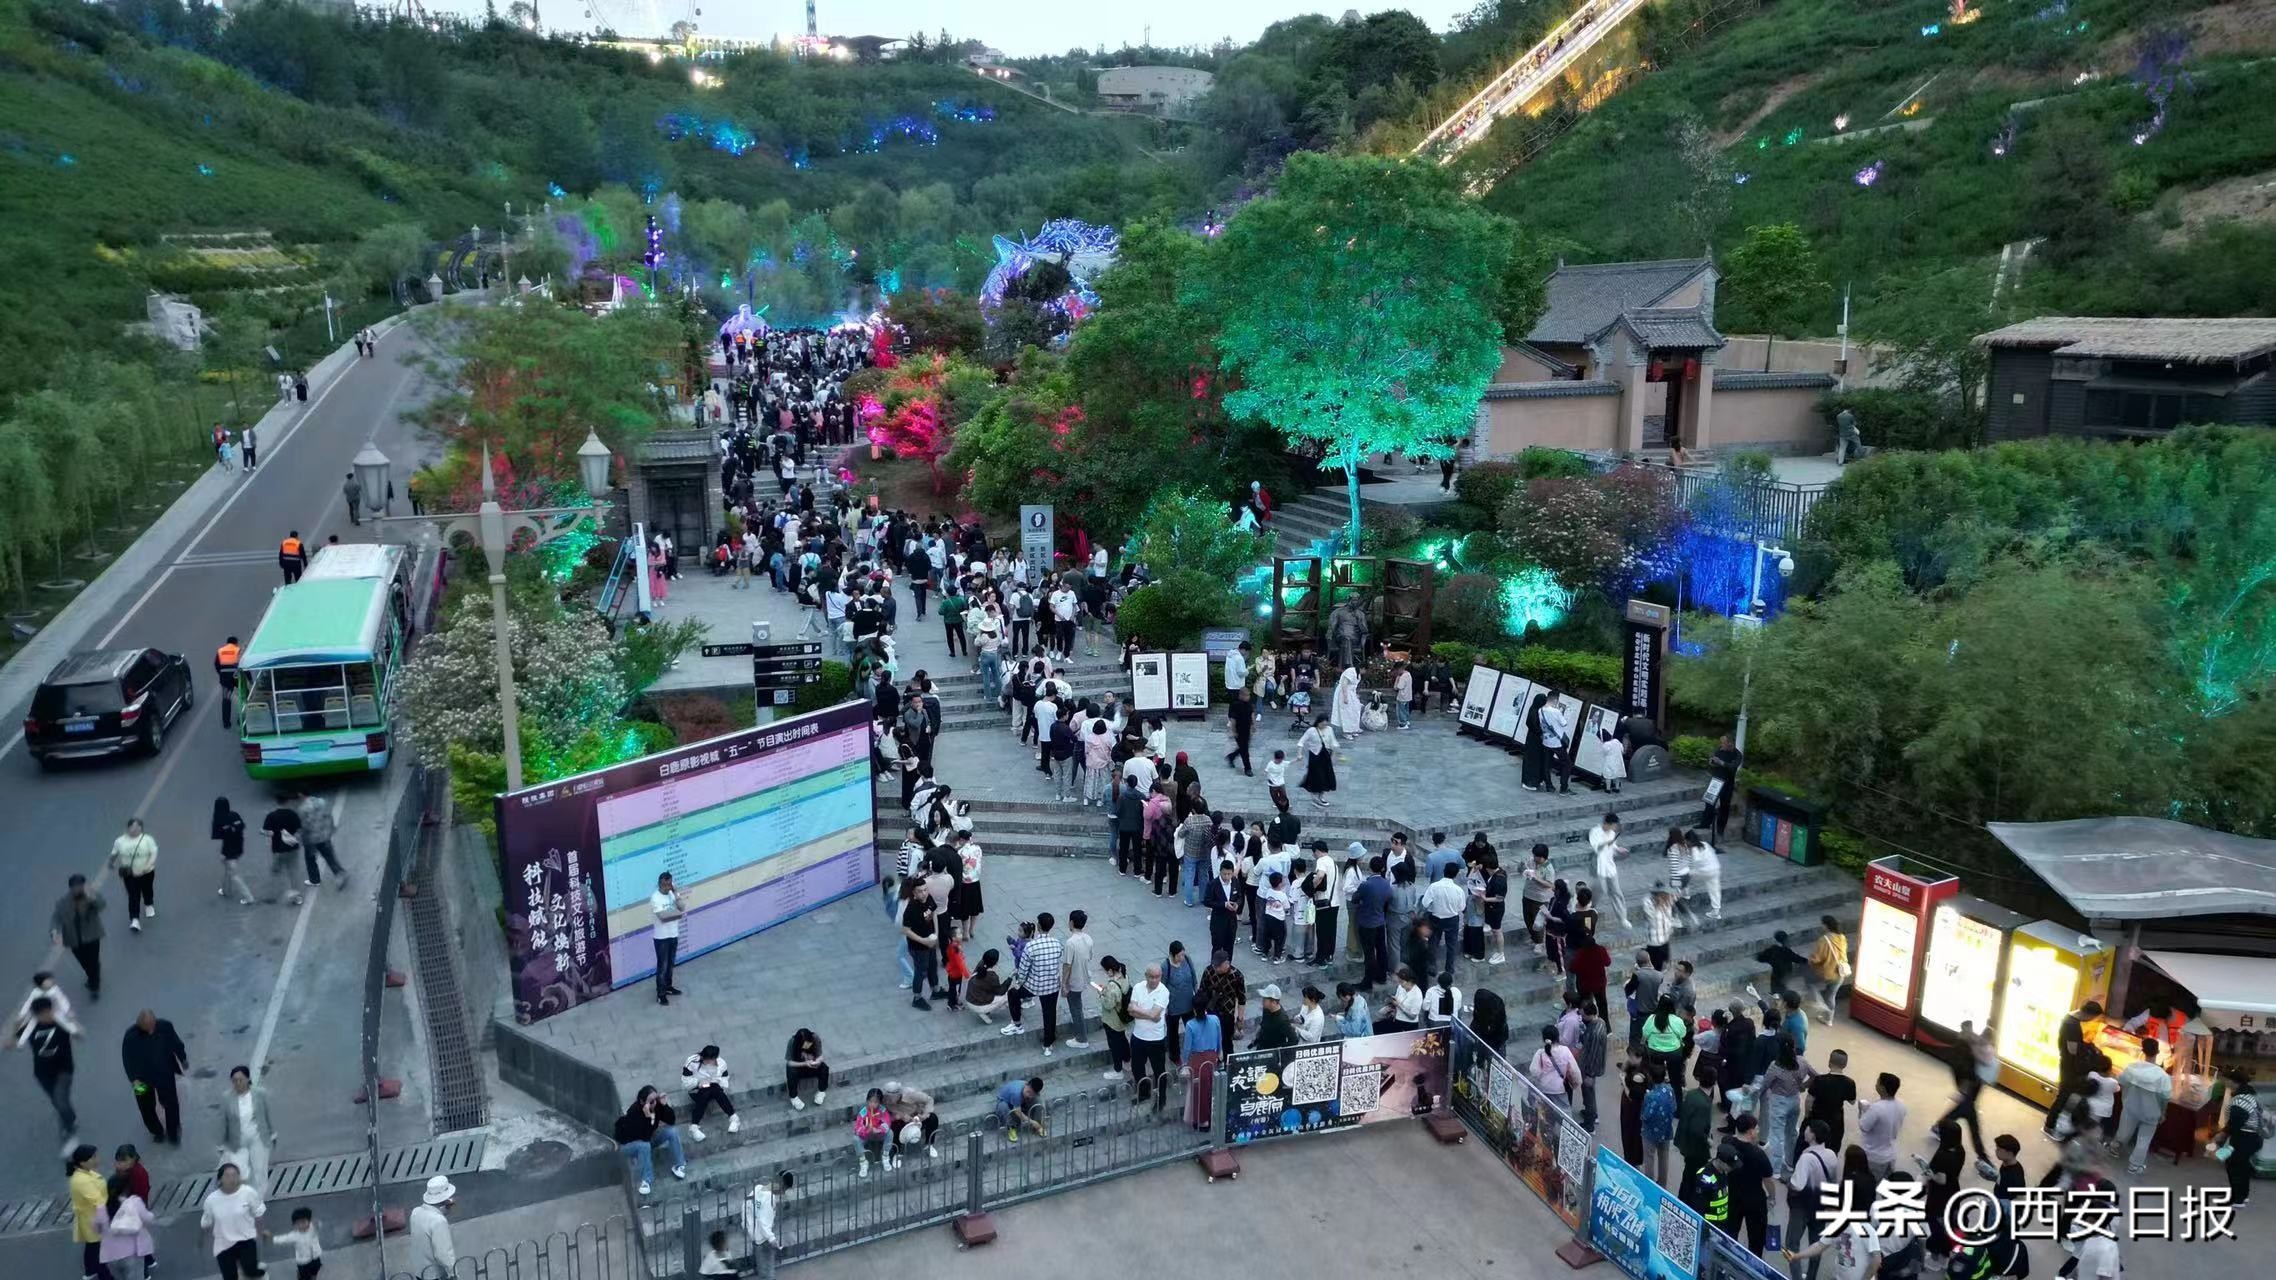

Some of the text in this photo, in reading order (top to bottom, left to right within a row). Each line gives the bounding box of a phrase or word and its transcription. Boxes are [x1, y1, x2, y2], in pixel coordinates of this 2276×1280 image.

[1640, 633, 1651, 707] 新时代文明实践基
[522, 861, 548, 950] 科技赋能
[1874, 875, 1911, 896] 农夫山泉
[550, 893, 570, 972] 文化焕新
[1240, 1095, 1285, 1117] 白鹿原
